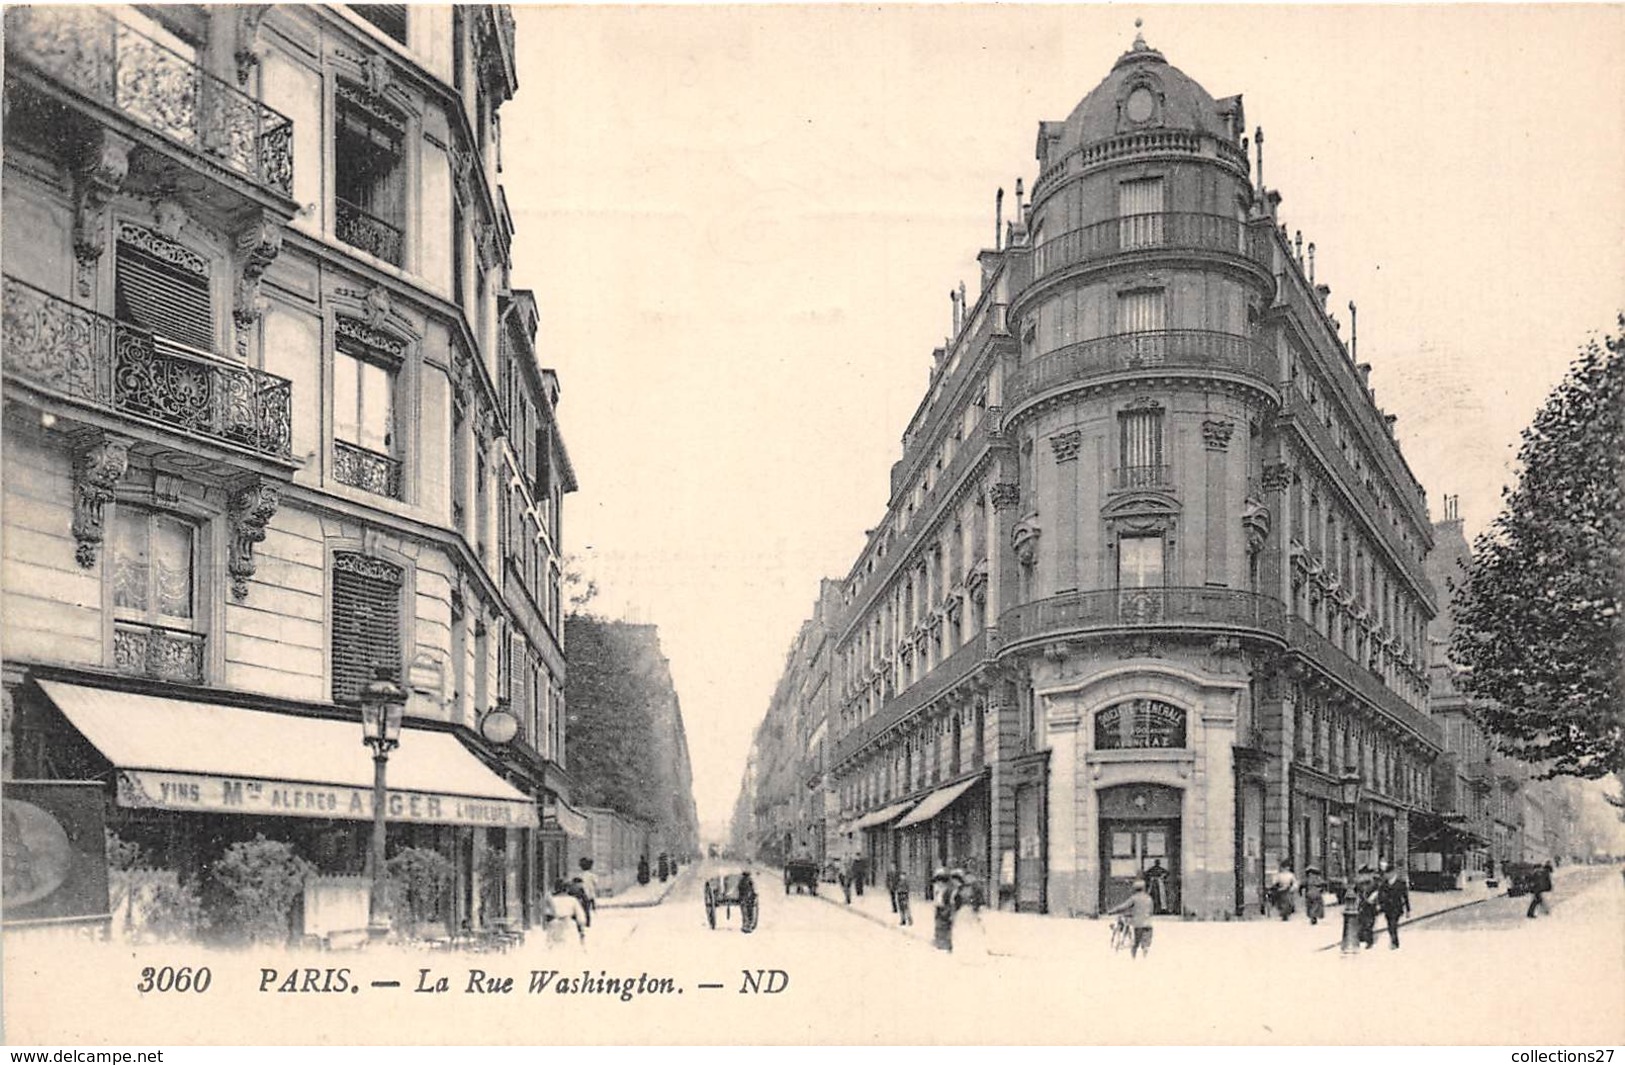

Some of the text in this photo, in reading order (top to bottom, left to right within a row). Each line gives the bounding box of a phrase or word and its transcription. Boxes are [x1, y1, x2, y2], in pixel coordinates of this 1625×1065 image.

[160, 782, 200, 802] VINS
[271, 790, 337, 811] ALFRED
[349, 792, 442, 818] AGER
